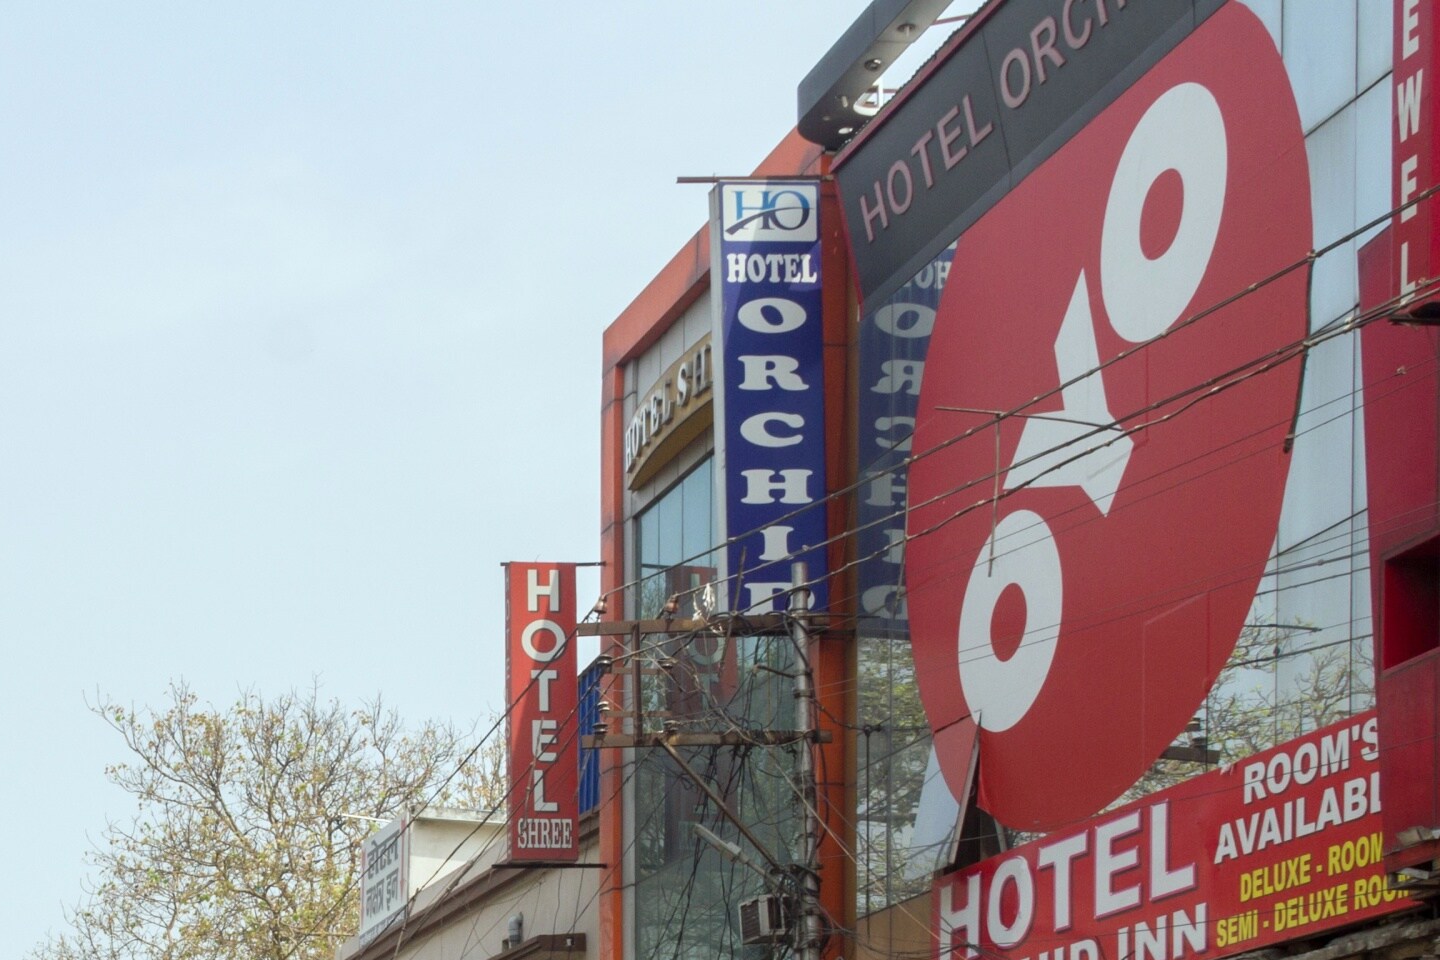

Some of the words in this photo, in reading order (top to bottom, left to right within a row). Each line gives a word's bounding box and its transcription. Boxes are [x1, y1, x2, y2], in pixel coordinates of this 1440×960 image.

[860, 94, 993, 242] HOTEL
[727, 253, 817, 283] HOTEL
[625, 379, 673, 473] HOTEL
[957, 81, 1229, 733] OYO
[737, 297, 815, 616] ORCHID
[521, 569, 566, 812] HOTEL
[517, 818, 573, 849] SHREE
[1240, 853, 1312, 902] DELUXE
[1216, 910, 1259, 948] SEMI
[1274, 884, 1349, 932] DELUXE
